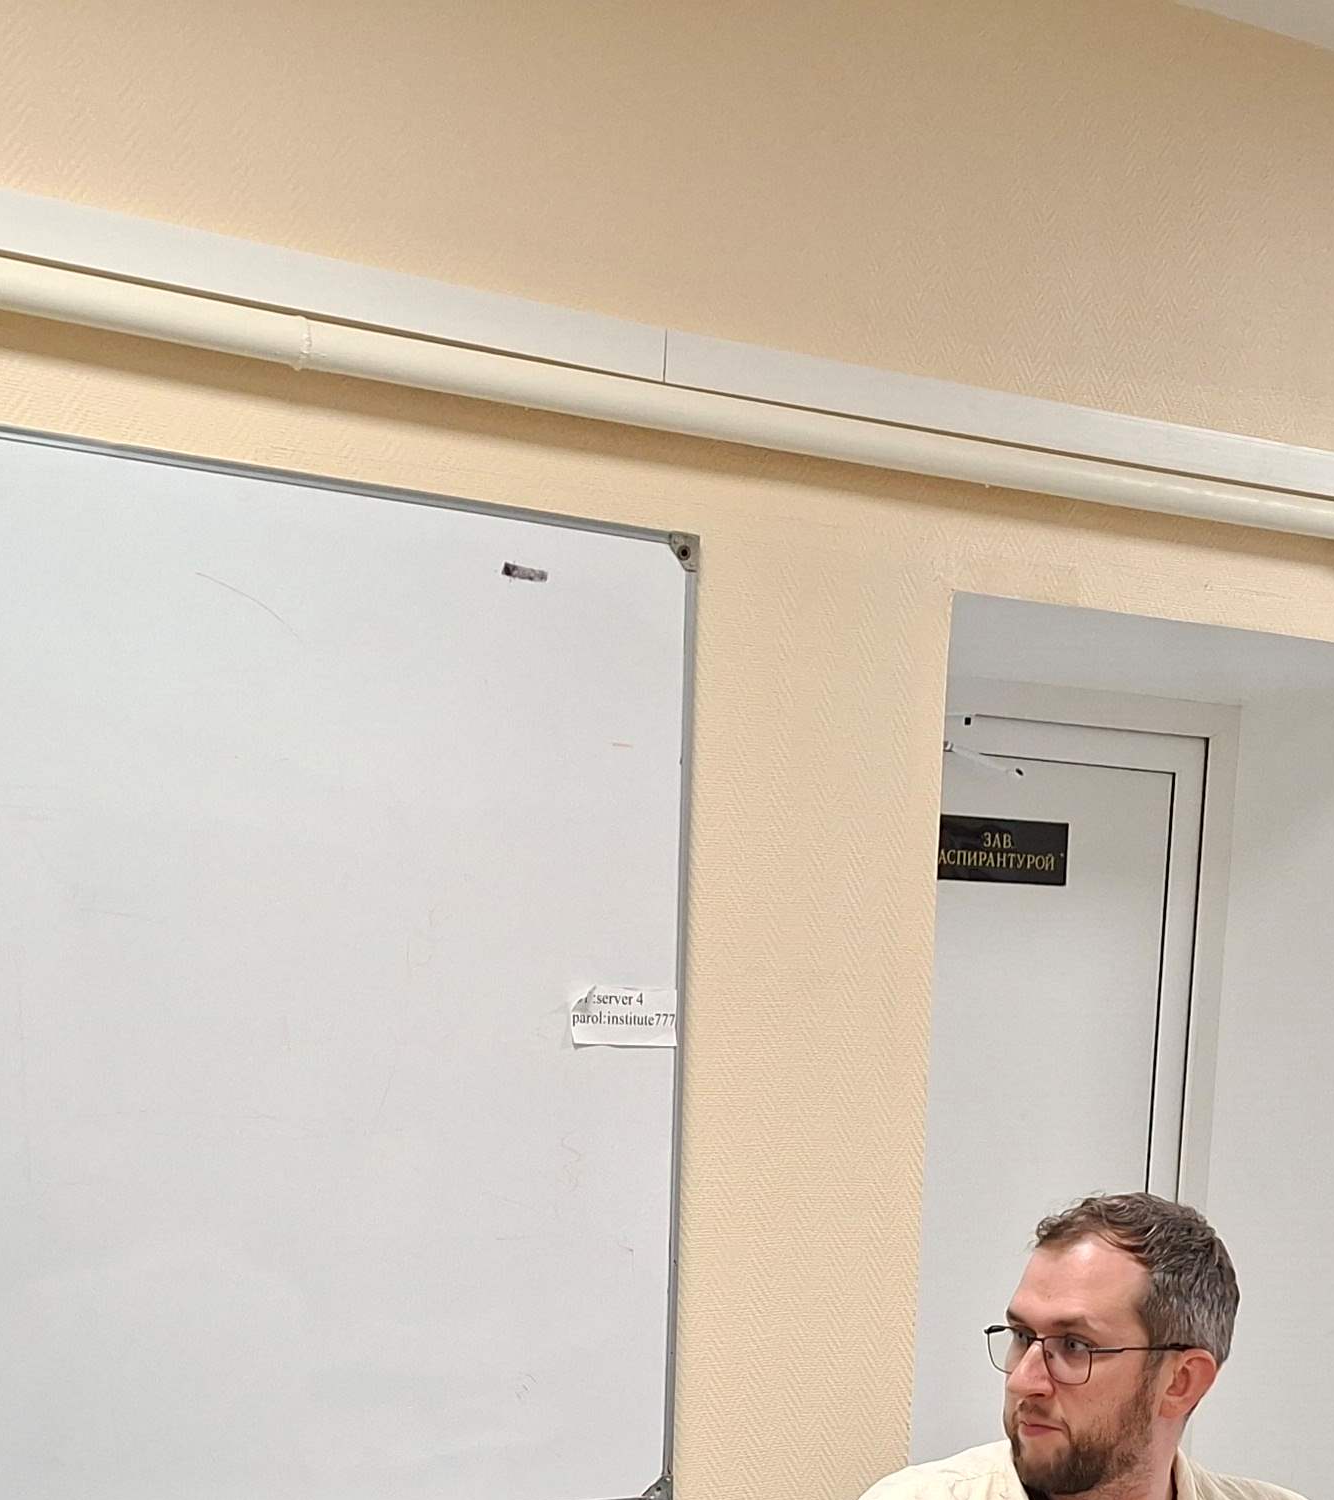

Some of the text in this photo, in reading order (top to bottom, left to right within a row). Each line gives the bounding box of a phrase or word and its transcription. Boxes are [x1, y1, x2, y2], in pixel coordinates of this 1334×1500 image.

[938, 848, 1055, 871] АСПИРАНТУРОЙ
[636, 992, 644, 1006] 4
[572, 1010, 676, 1027] parol:institute777
